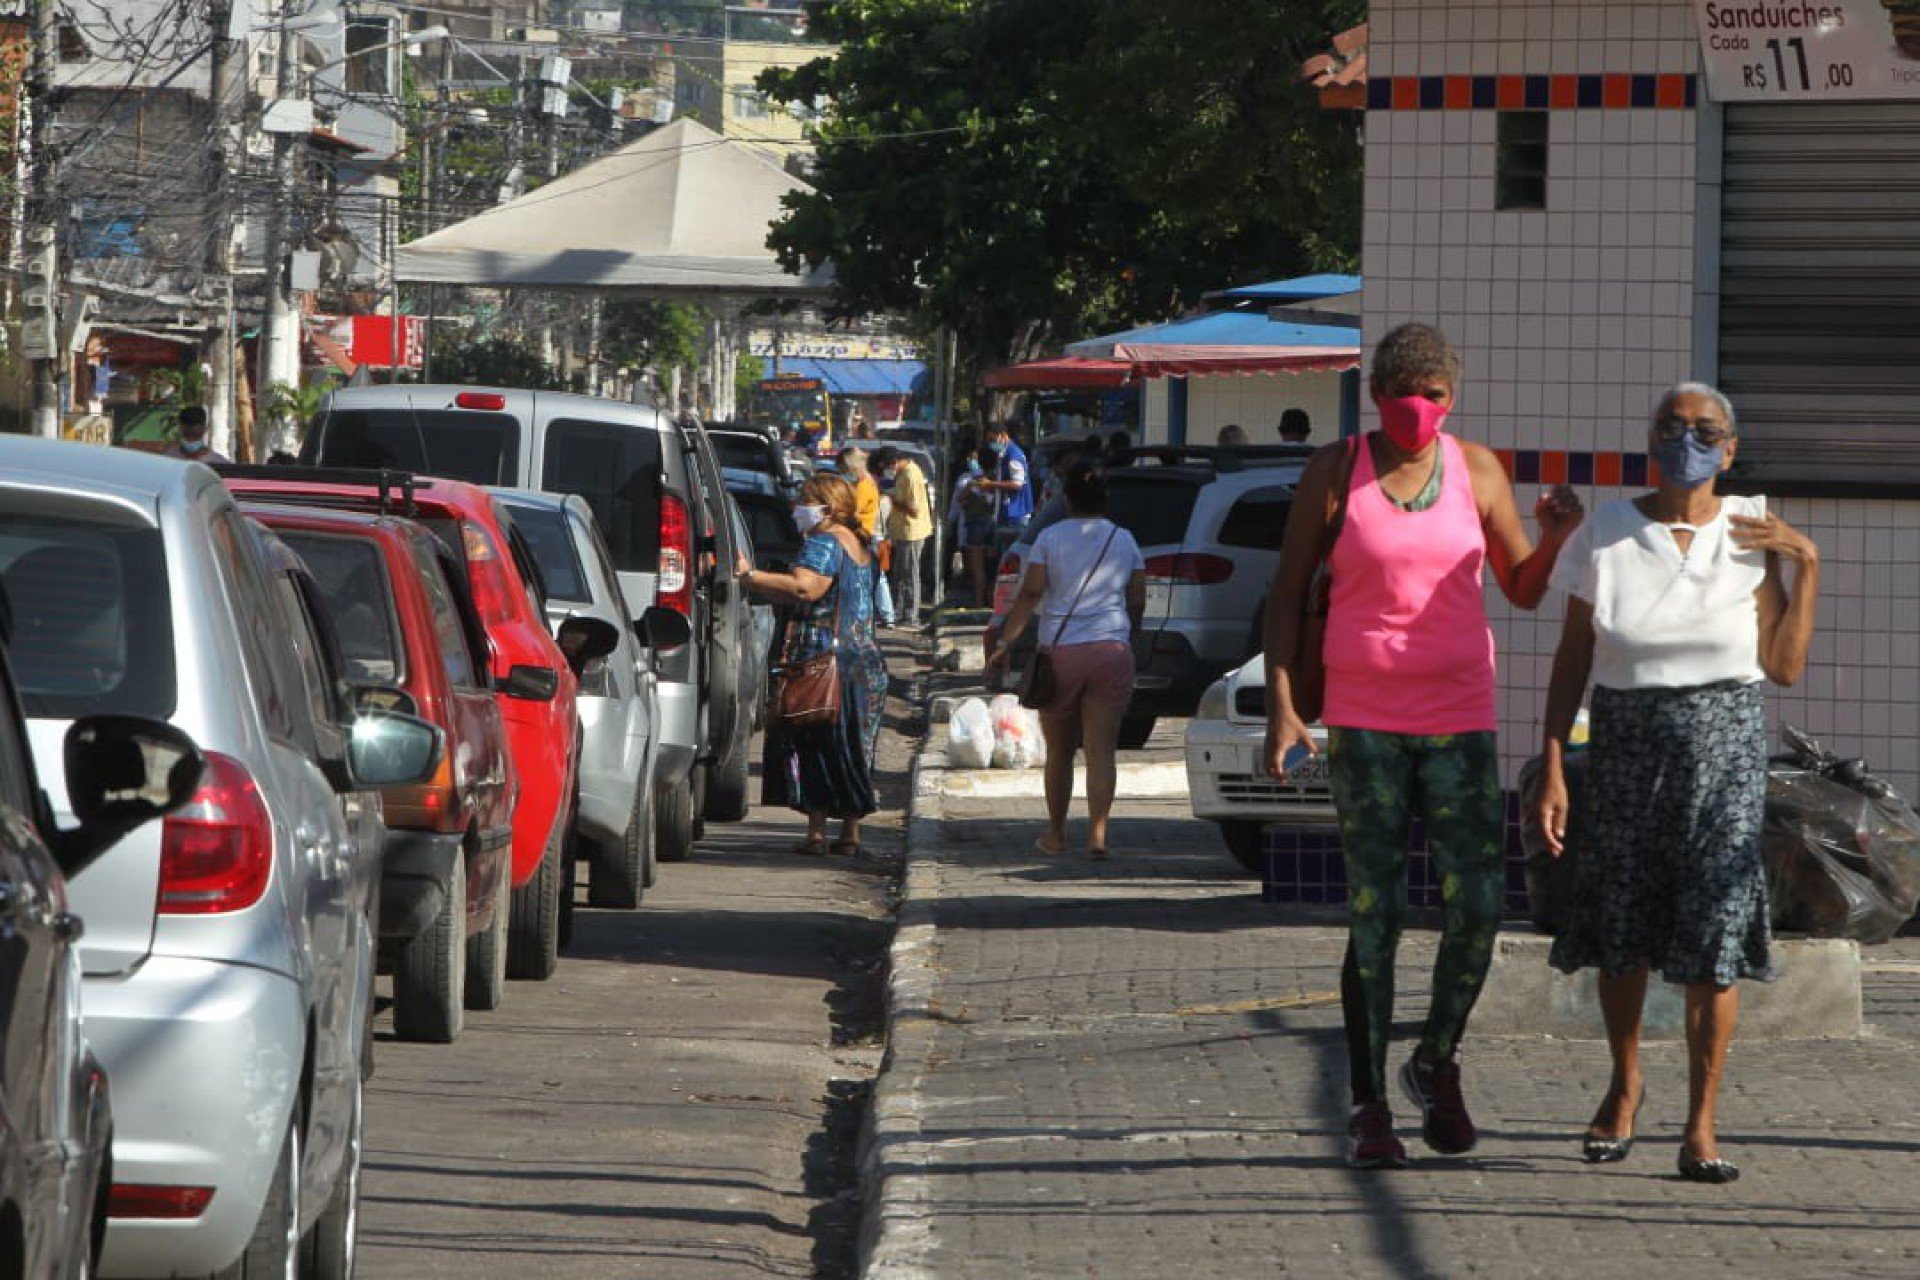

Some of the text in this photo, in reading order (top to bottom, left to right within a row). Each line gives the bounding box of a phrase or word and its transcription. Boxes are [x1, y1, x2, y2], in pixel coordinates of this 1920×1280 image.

[1710, 34, 1749, 50] Cada
[1742, 63, 1768, 91] R$
[1766, 37, 1810, 91] 11
